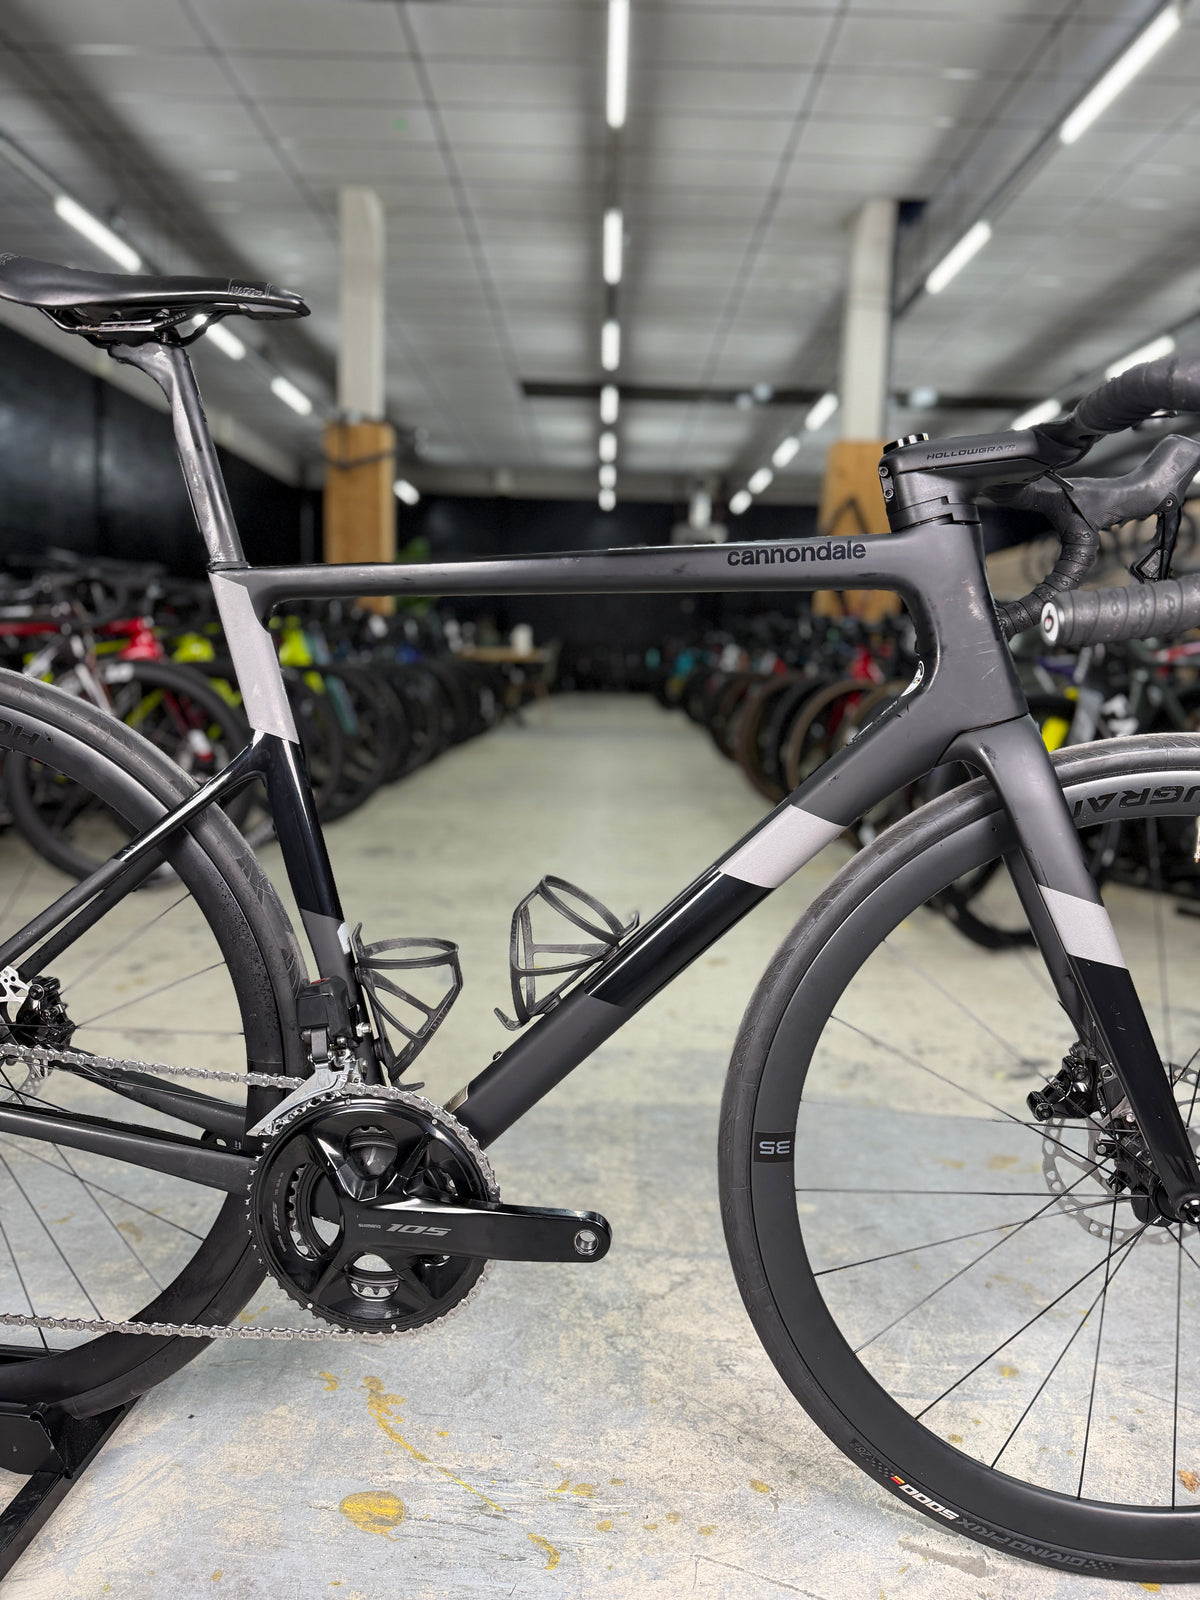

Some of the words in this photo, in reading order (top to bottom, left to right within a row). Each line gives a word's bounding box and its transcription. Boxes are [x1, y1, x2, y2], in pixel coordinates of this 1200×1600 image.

[926, 444, 1016, 460] HOLLOWGRAM
[727, 540, 867, 566] cannondale
[759, 1140, 791, 1155] 35
[386, 1223, 452, 1237] 105
[899, 1484, 960, 1520] 5000
[956, 1517, 1010, 1544] PRIX
[1008, 1540, 1087, 1567] GRAND
